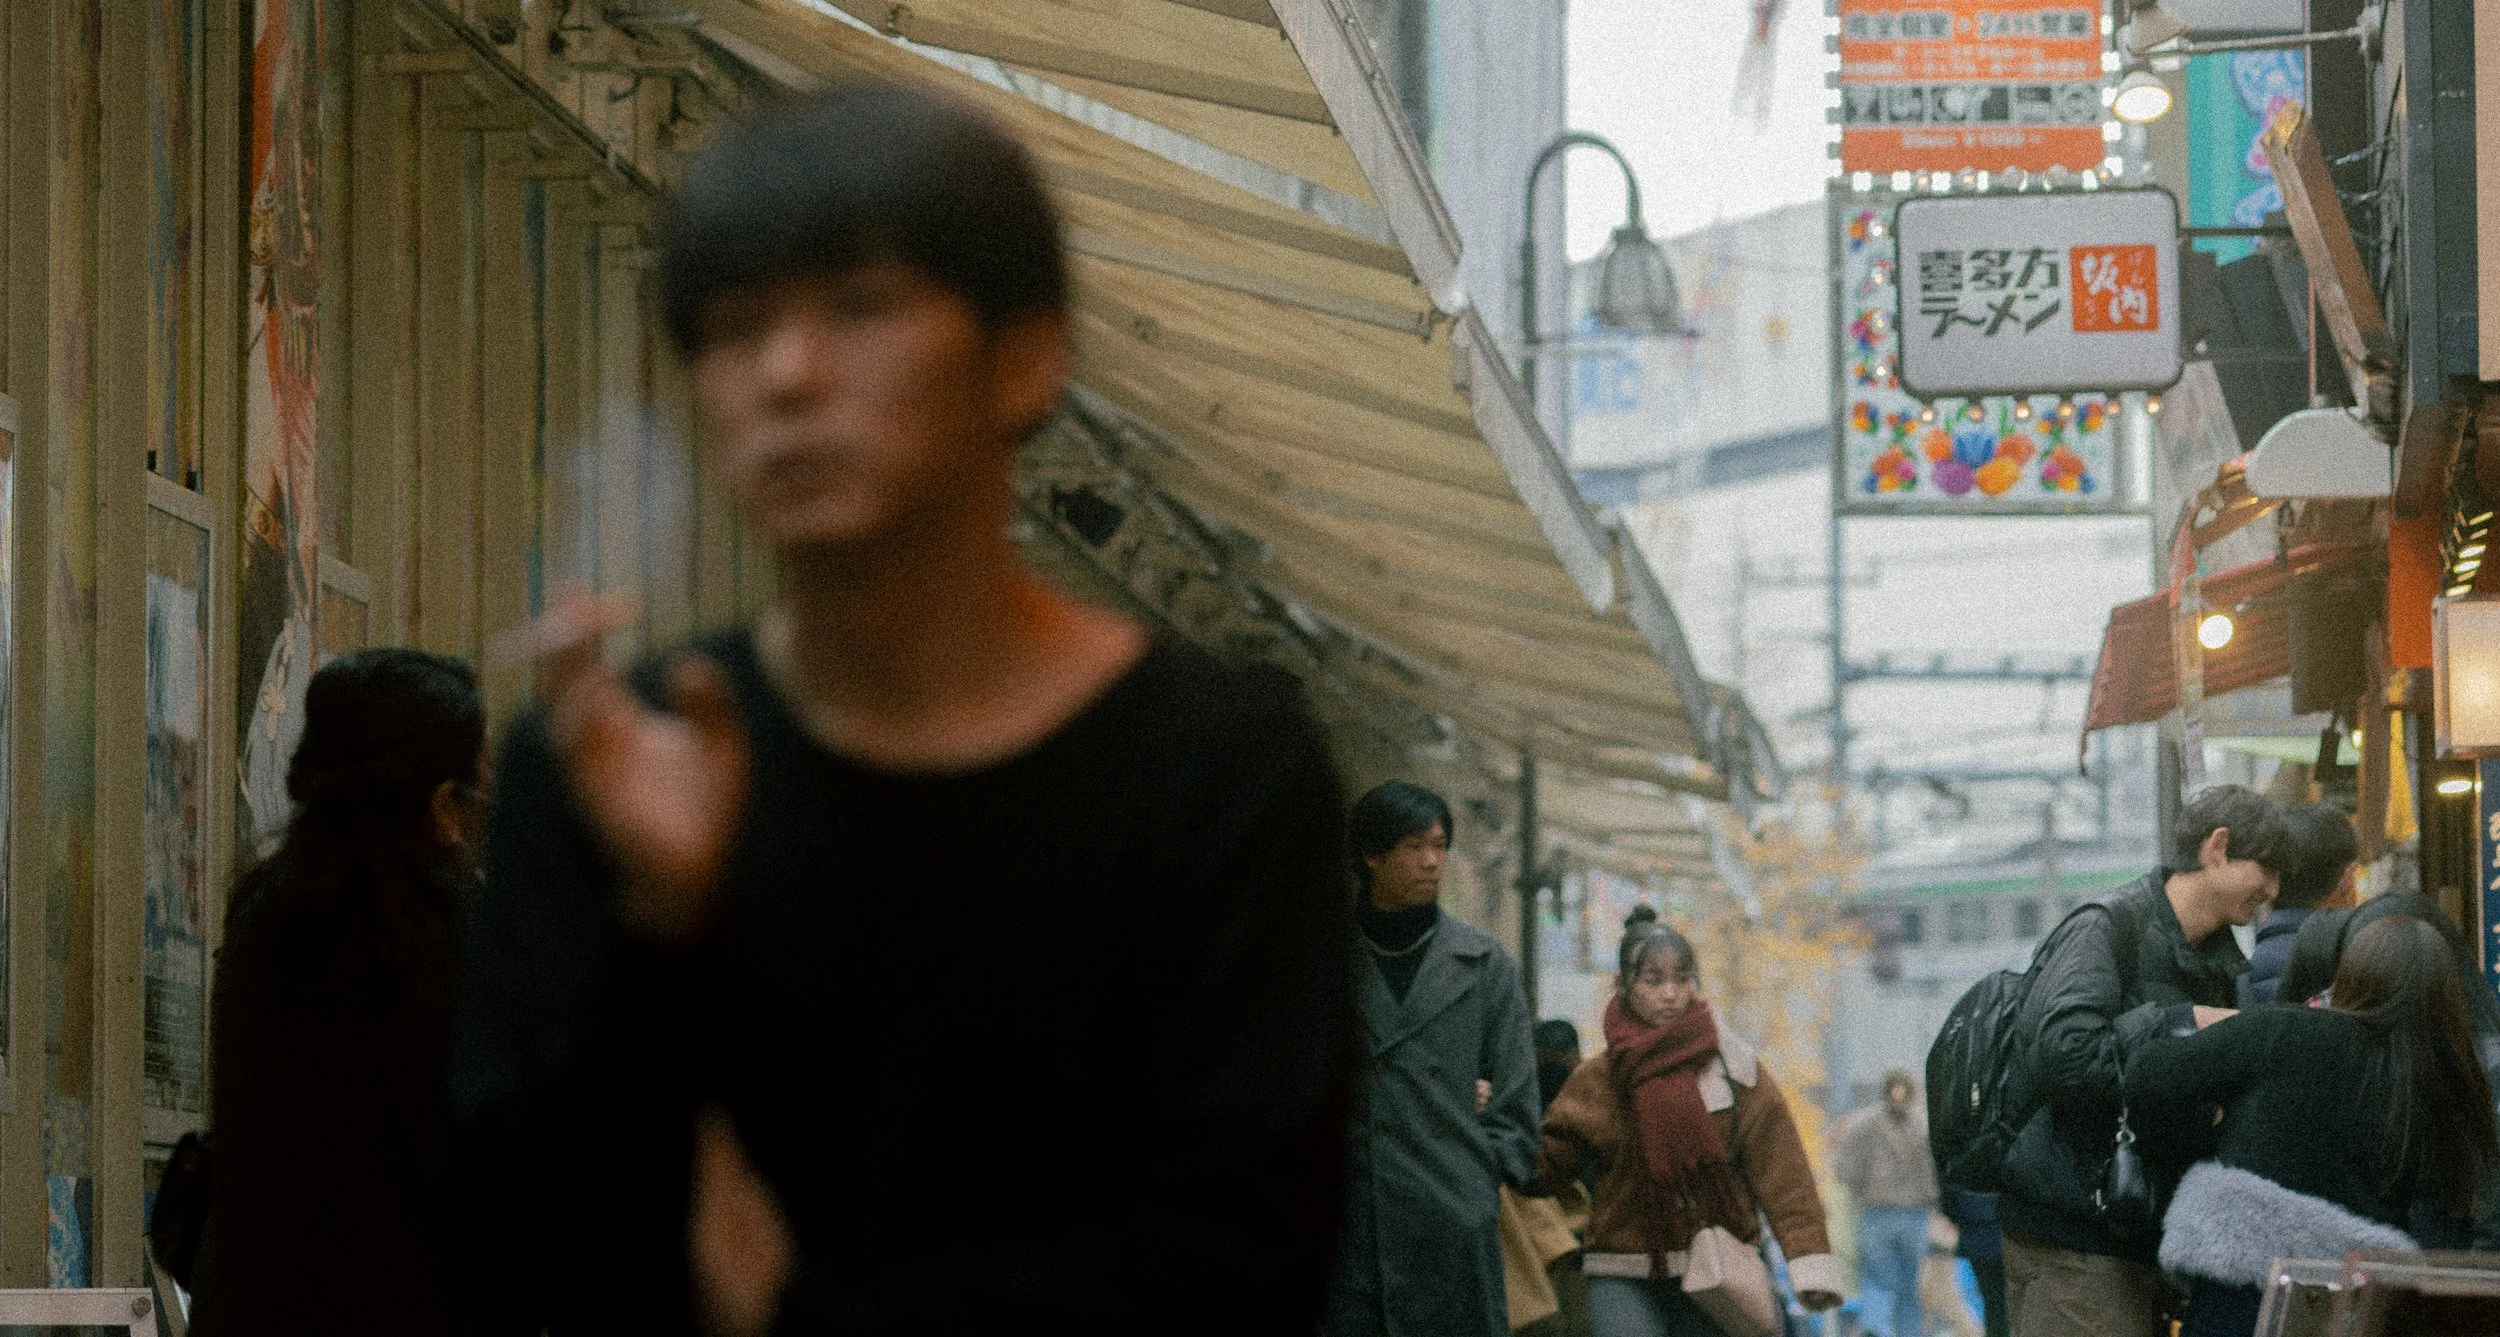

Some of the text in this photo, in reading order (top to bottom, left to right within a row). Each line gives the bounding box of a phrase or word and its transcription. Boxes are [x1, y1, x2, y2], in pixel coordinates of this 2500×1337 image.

[1919, 247, 2060, 292] 喜多方
[2080, 251, 2149, 325] 坂内
[1920, 293, 2061, 338] ラーメン
